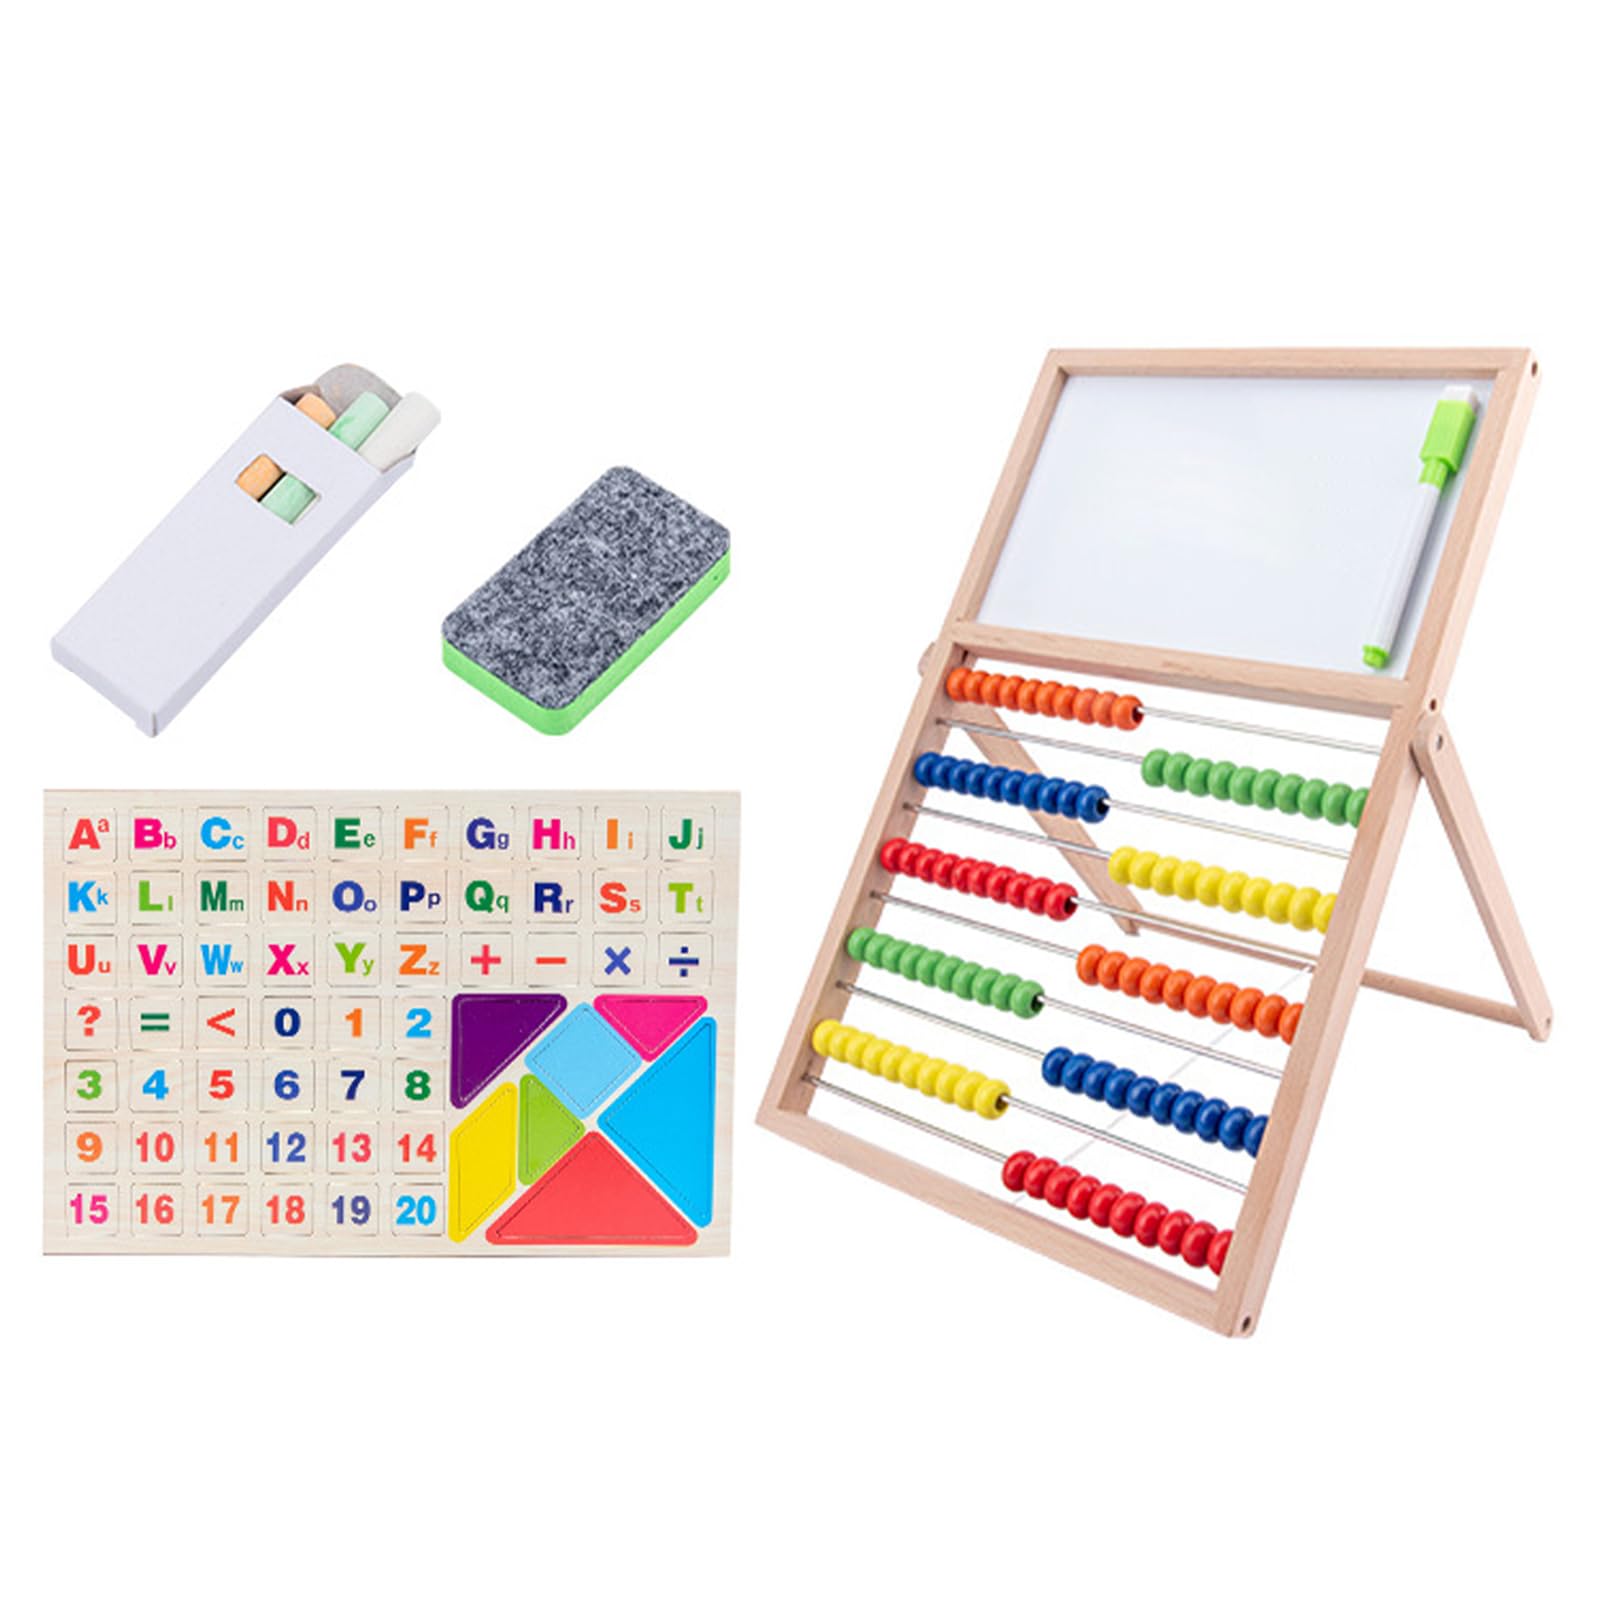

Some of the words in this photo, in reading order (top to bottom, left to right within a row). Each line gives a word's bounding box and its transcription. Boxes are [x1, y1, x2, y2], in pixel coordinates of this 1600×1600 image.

[67, 816, 110, 851] Aa
[133, 816, 177, 850] Bb
[199, 815, 245, 851] Cc
[266, 815, 311, 851] Dd
[334, 817, 376, 849] Ee
[402, 816, 438, 851] Ff
[466, 817, 510, 851] Gg
[531, 817, 577, 851] Hh
[606, 817, 634, 851] Ii
[668, 818, 704, 851] Jj
[67, 880, 109, 913] Kk
[138, 879, 174, 913] Ll
[200, 880, 244, 912] Mm
[266, 879, 310, 913] Nn
[332, 880, 377, 913] Oo
[400, 881, 441, 913] Pp
[464, 880, 509, 914] Qq
[533, 882, 575, 913] Rr
[598, 880, 642, 915] Ss
[667, 881, 704, 914] Tt
[66, 943, 112, 977] Uu
[136, 943, 177, 977] Vv
[200, 943, 244, 976] Ww
[266, 943, 310, 977] Xx
[335, 942, 375, 977] Yy
[398, 943, 442, 977] Zz
[274, 1007, 301, 1037] 0
[343, 1006, 364, 1040] 1
[405, 1007, 433, 1039] 2
[76, 1069, 103, 1101] 3
[141, 1068, 170, 1101] 4
[207, 1068, 236, 1102] 5
[274, 1069, 300, 1100] 6
[340, 1069, 365, 1100] 7
[404, 1069, 431, 1101] 8
[75, 1130, 104, 1164] 9
[134, 1130, 175, 1164] 10
[202, 1130, 239, 1165] 11
[266, 1132, 306, 1163] 12
[331, 1131, 372, 1164] 13
[396, 1132, 438, 1164] 14
[69, 1192, 110, 1225] 15
[135, 1192, 175, 1225] 16
[200, 1193, 241, 1226] 17
[265, 1194, 306, 1226] 18
[332, 1195, 371, 1225] 19
[395, 1194, 437, 1227] 20
